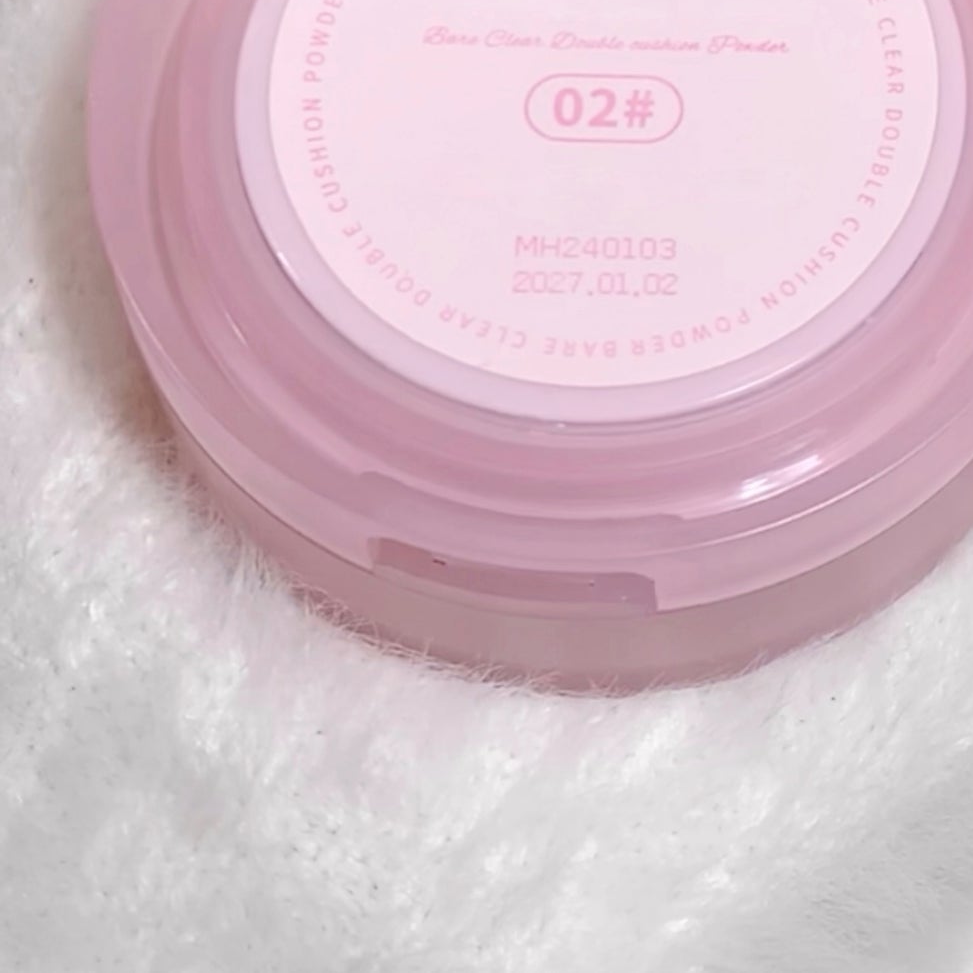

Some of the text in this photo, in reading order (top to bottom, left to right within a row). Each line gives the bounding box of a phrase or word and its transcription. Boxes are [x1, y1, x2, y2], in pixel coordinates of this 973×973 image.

[878, 15, 905, 96] CLEAR
[551, 86, 656, 129] 02#
[300, 97, 351, 215] CUSHION
[856, 107, 905, 210] DOUBLE
[339, 222, 433, 308] DOUBLE
[513, 234, 677, 260] MH240103
[757, 213, 862, 311] CUSHION
[510, 271, 679, 297] 2027.01.02
[437, 304, 529, 351] CLEAR
[543, 336, 618, 359] BARE
[629, 306, 753, 359] POWDER
